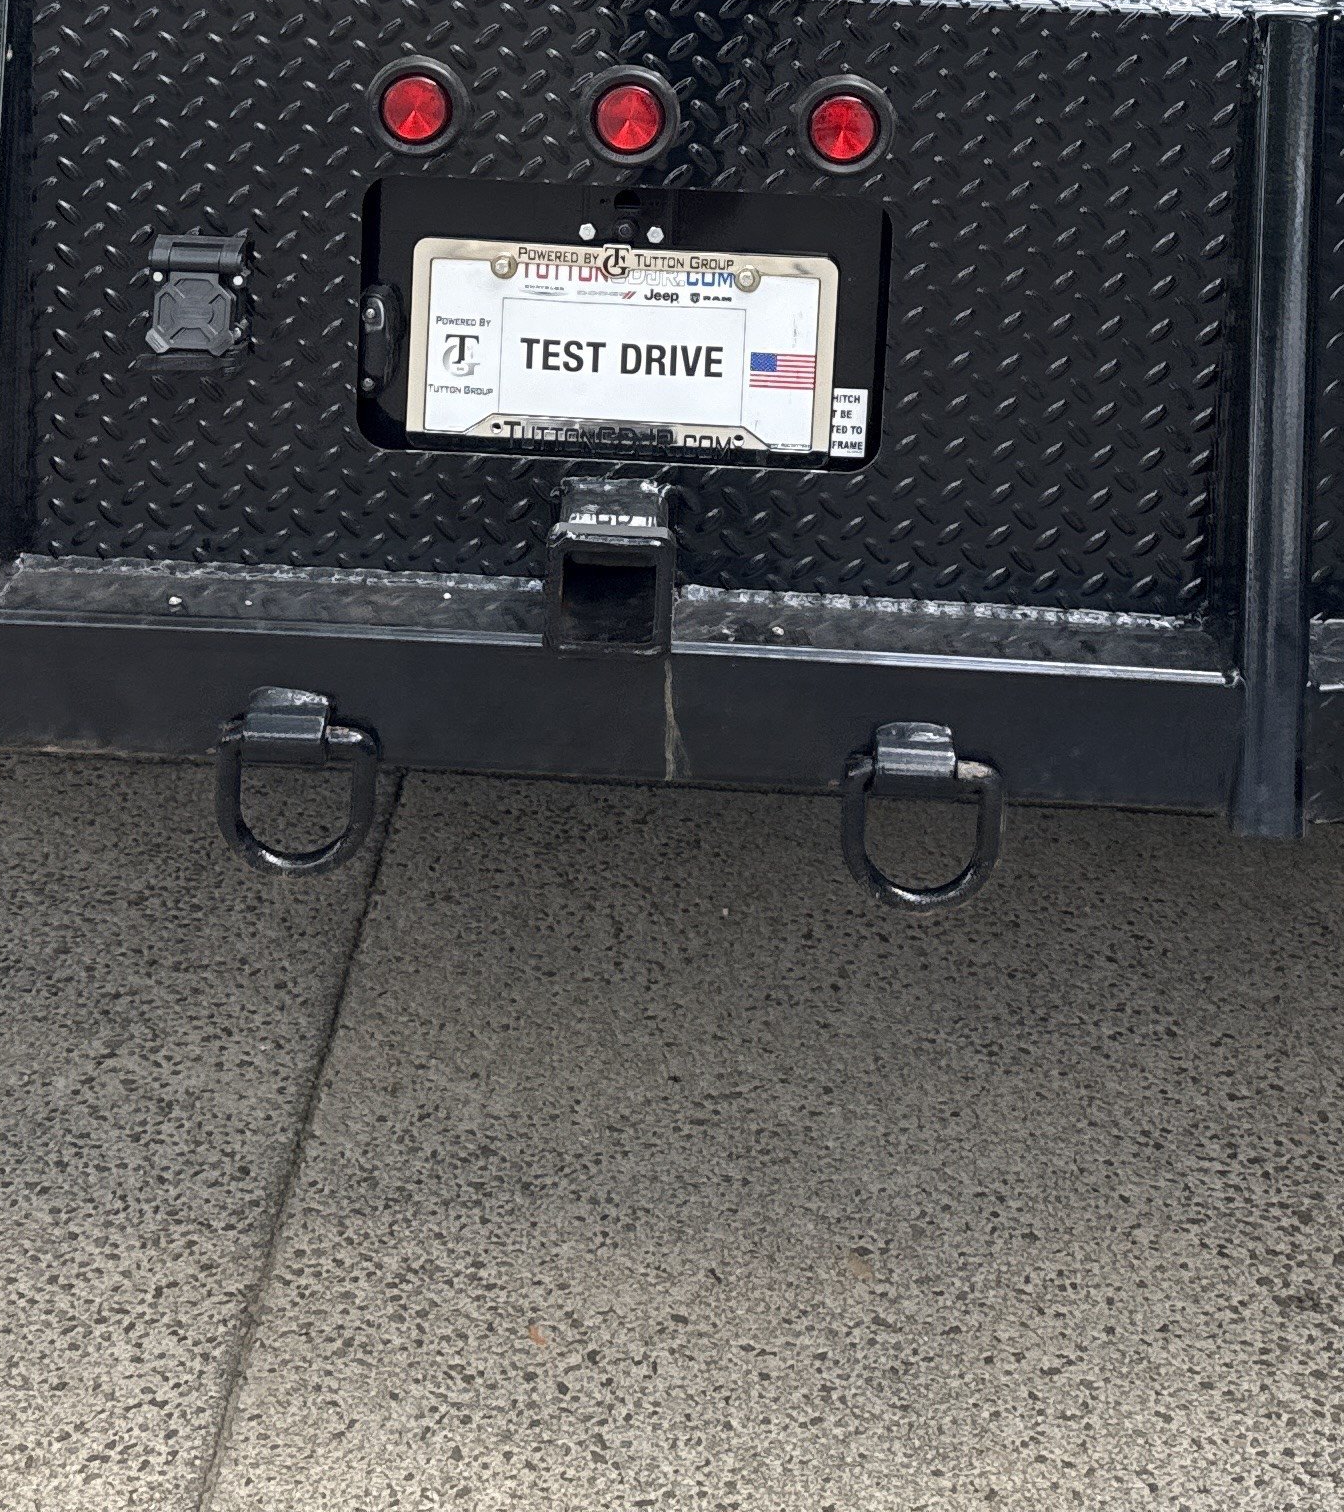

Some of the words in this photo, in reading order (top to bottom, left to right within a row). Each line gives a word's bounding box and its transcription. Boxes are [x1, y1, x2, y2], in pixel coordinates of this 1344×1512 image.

[518, 246, 579, 263] POWERED
[584, 253, 599, 265] BY
[634, 253, 685, 269] TUTTON
[689, 256, 735, 271] GROUP
[644, 288, 680, 303] Jeep
[436, 315, 476, 326] POWERED
[520, 337, 607, 373] TEST
[620, 342, 724, 378] DRIVE
[428, 383, 462, 394] TUTTON
[840, 409, 853, 419] BE
[850, 425, 863, 435] TO
[831, 440, 863, 451] FRAME
